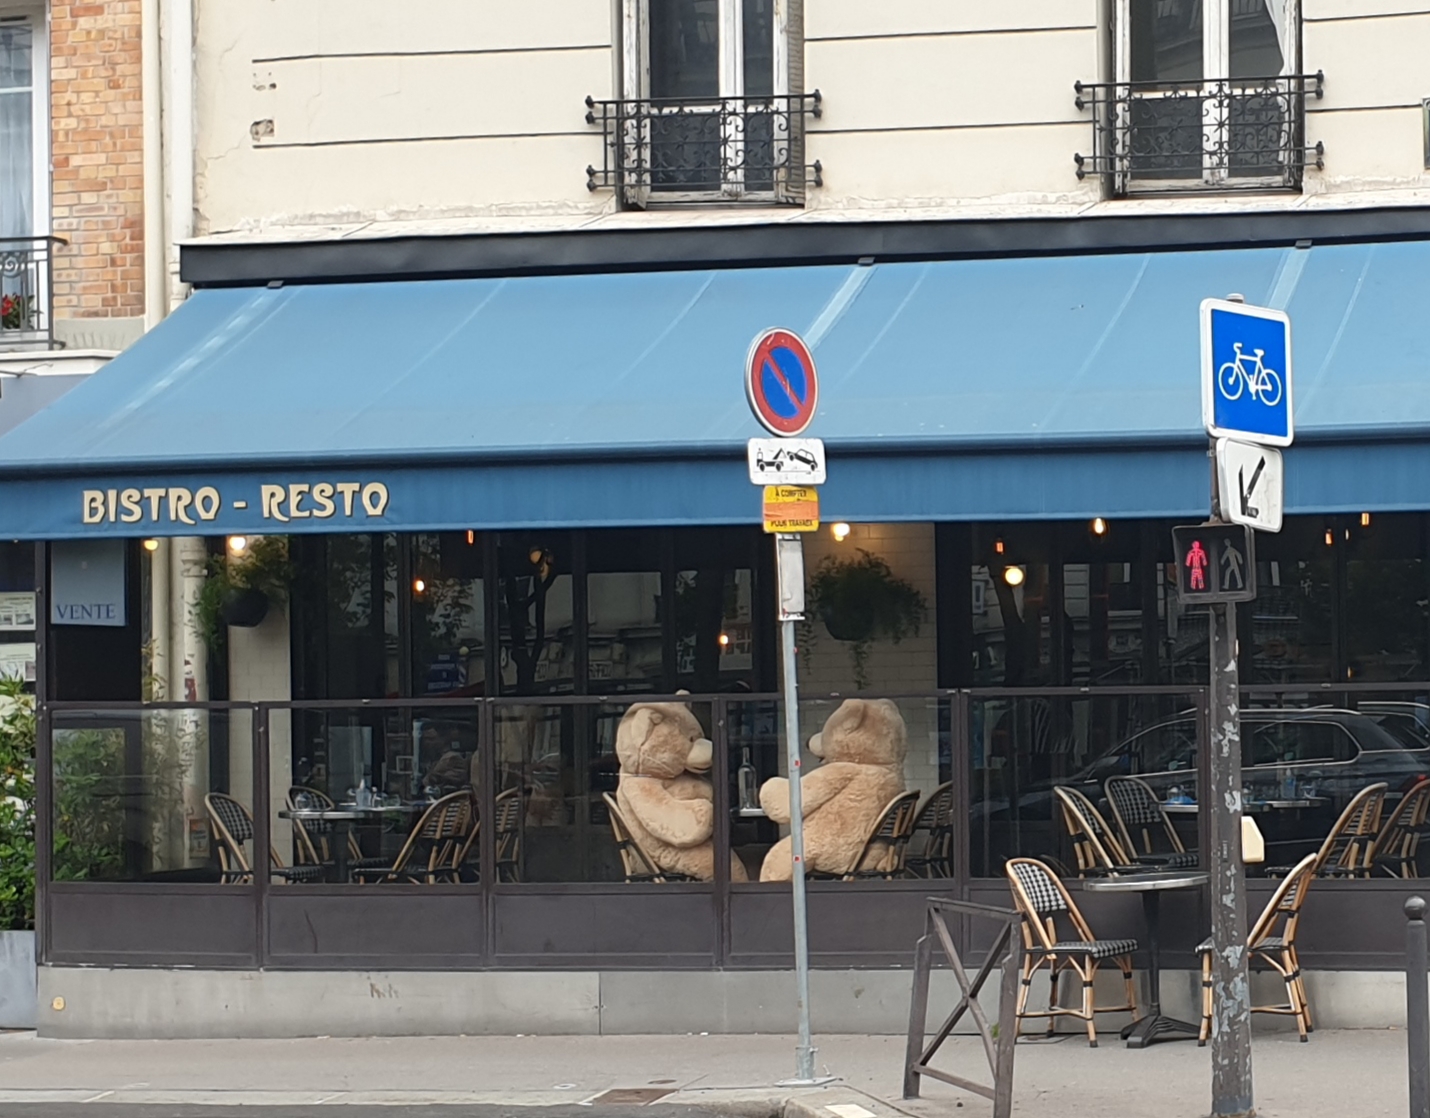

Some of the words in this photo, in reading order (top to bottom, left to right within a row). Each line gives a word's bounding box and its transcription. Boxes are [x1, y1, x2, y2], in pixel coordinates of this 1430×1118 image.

[82, 486, 221, 525] BISTRO
[260, 481, 390, 522] RESTO
[55, 603, 117, 620] VENTE
